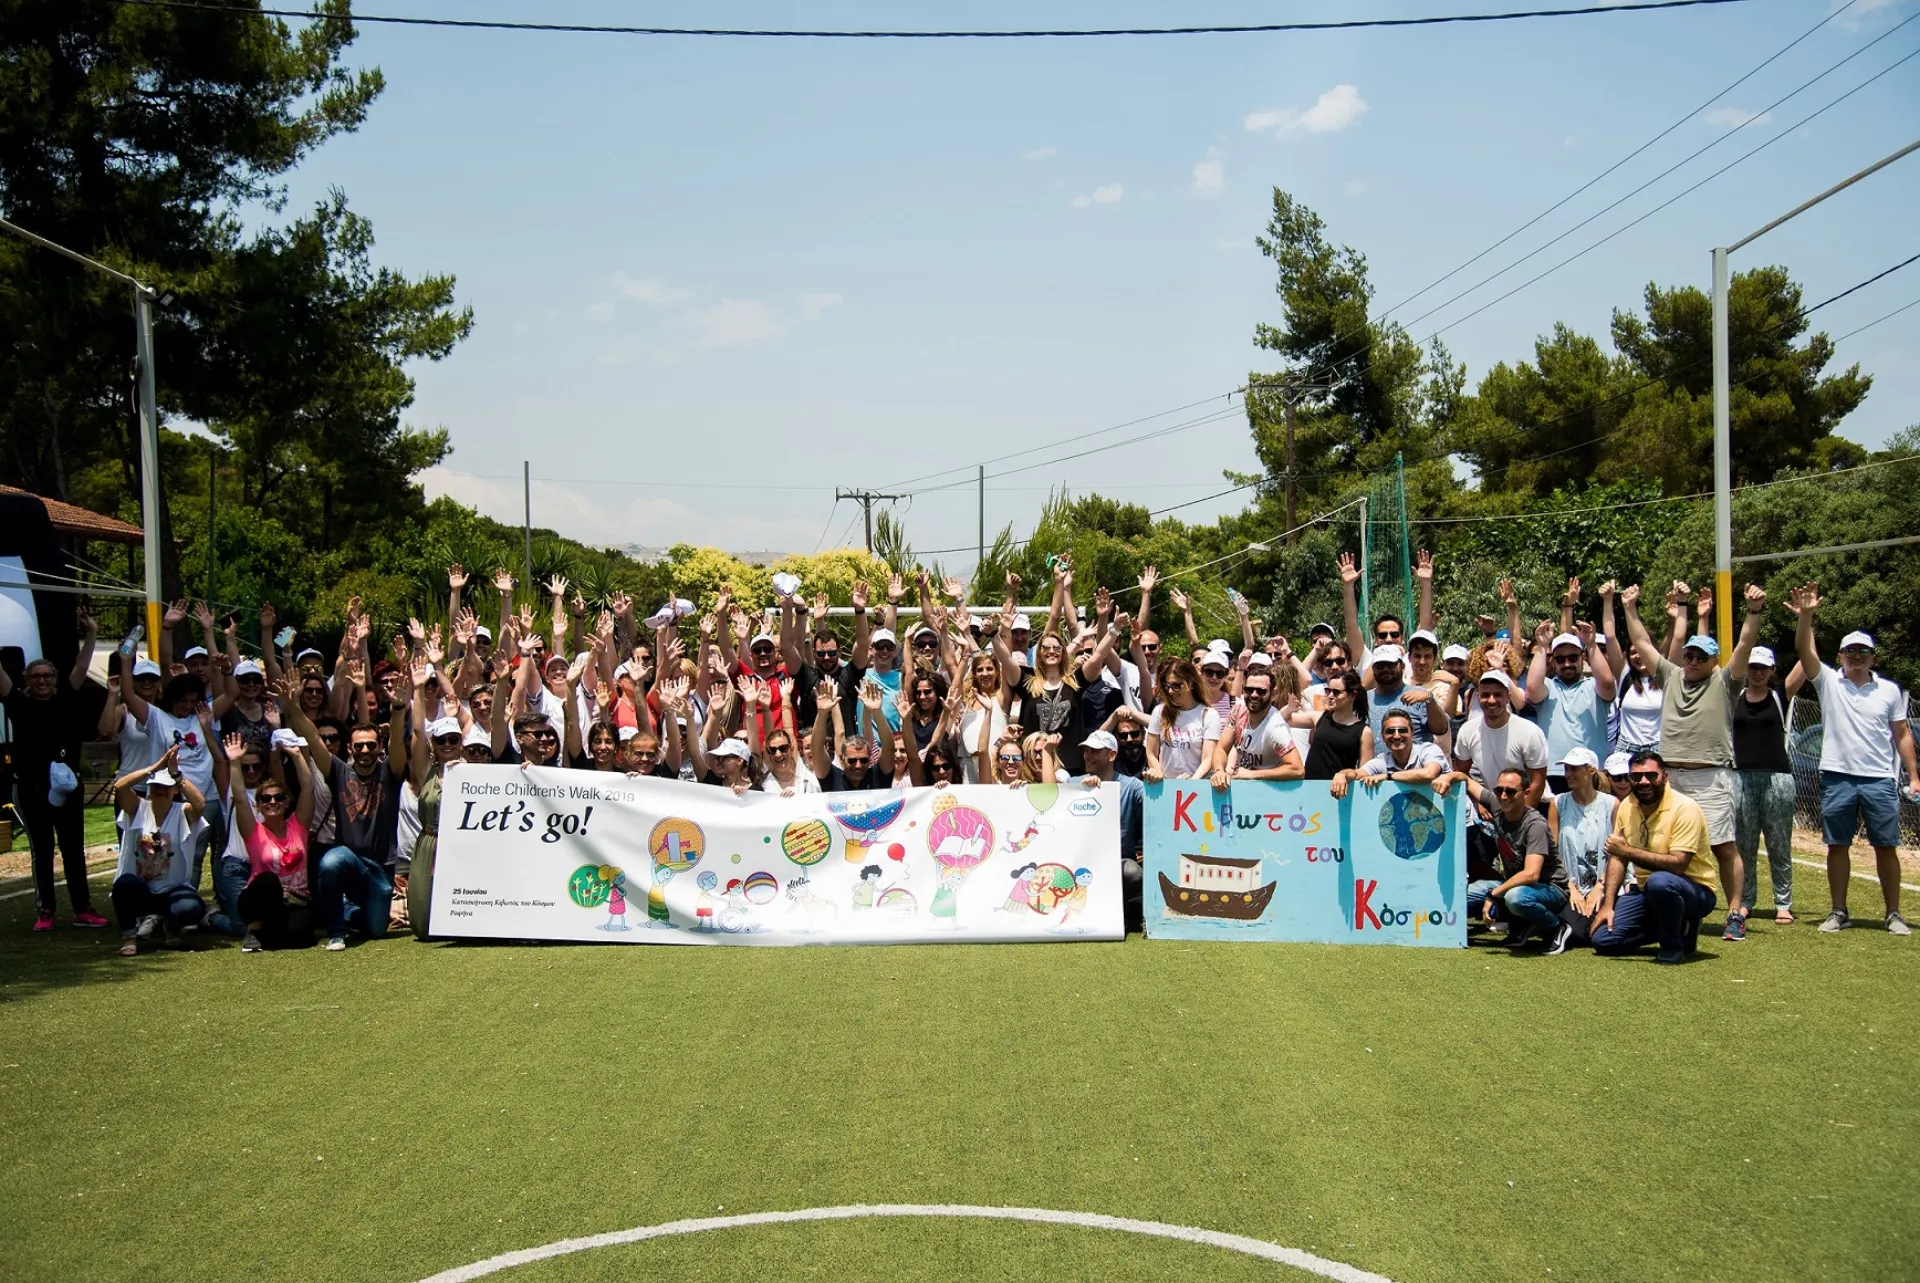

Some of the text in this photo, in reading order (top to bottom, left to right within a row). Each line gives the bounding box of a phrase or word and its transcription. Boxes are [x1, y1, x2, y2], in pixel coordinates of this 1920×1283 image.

[461, 781, 635, 802] Roche Children's Walk 2019
[1073, 802, 1097, 811] Roche
[457, 800, 594, 843] Let's go!
[1173, 790, 1322, 837] Κιβωτός
[1305, 846, 1345, 863] του
[1354, 878, 1457, 939] Κόσμου
